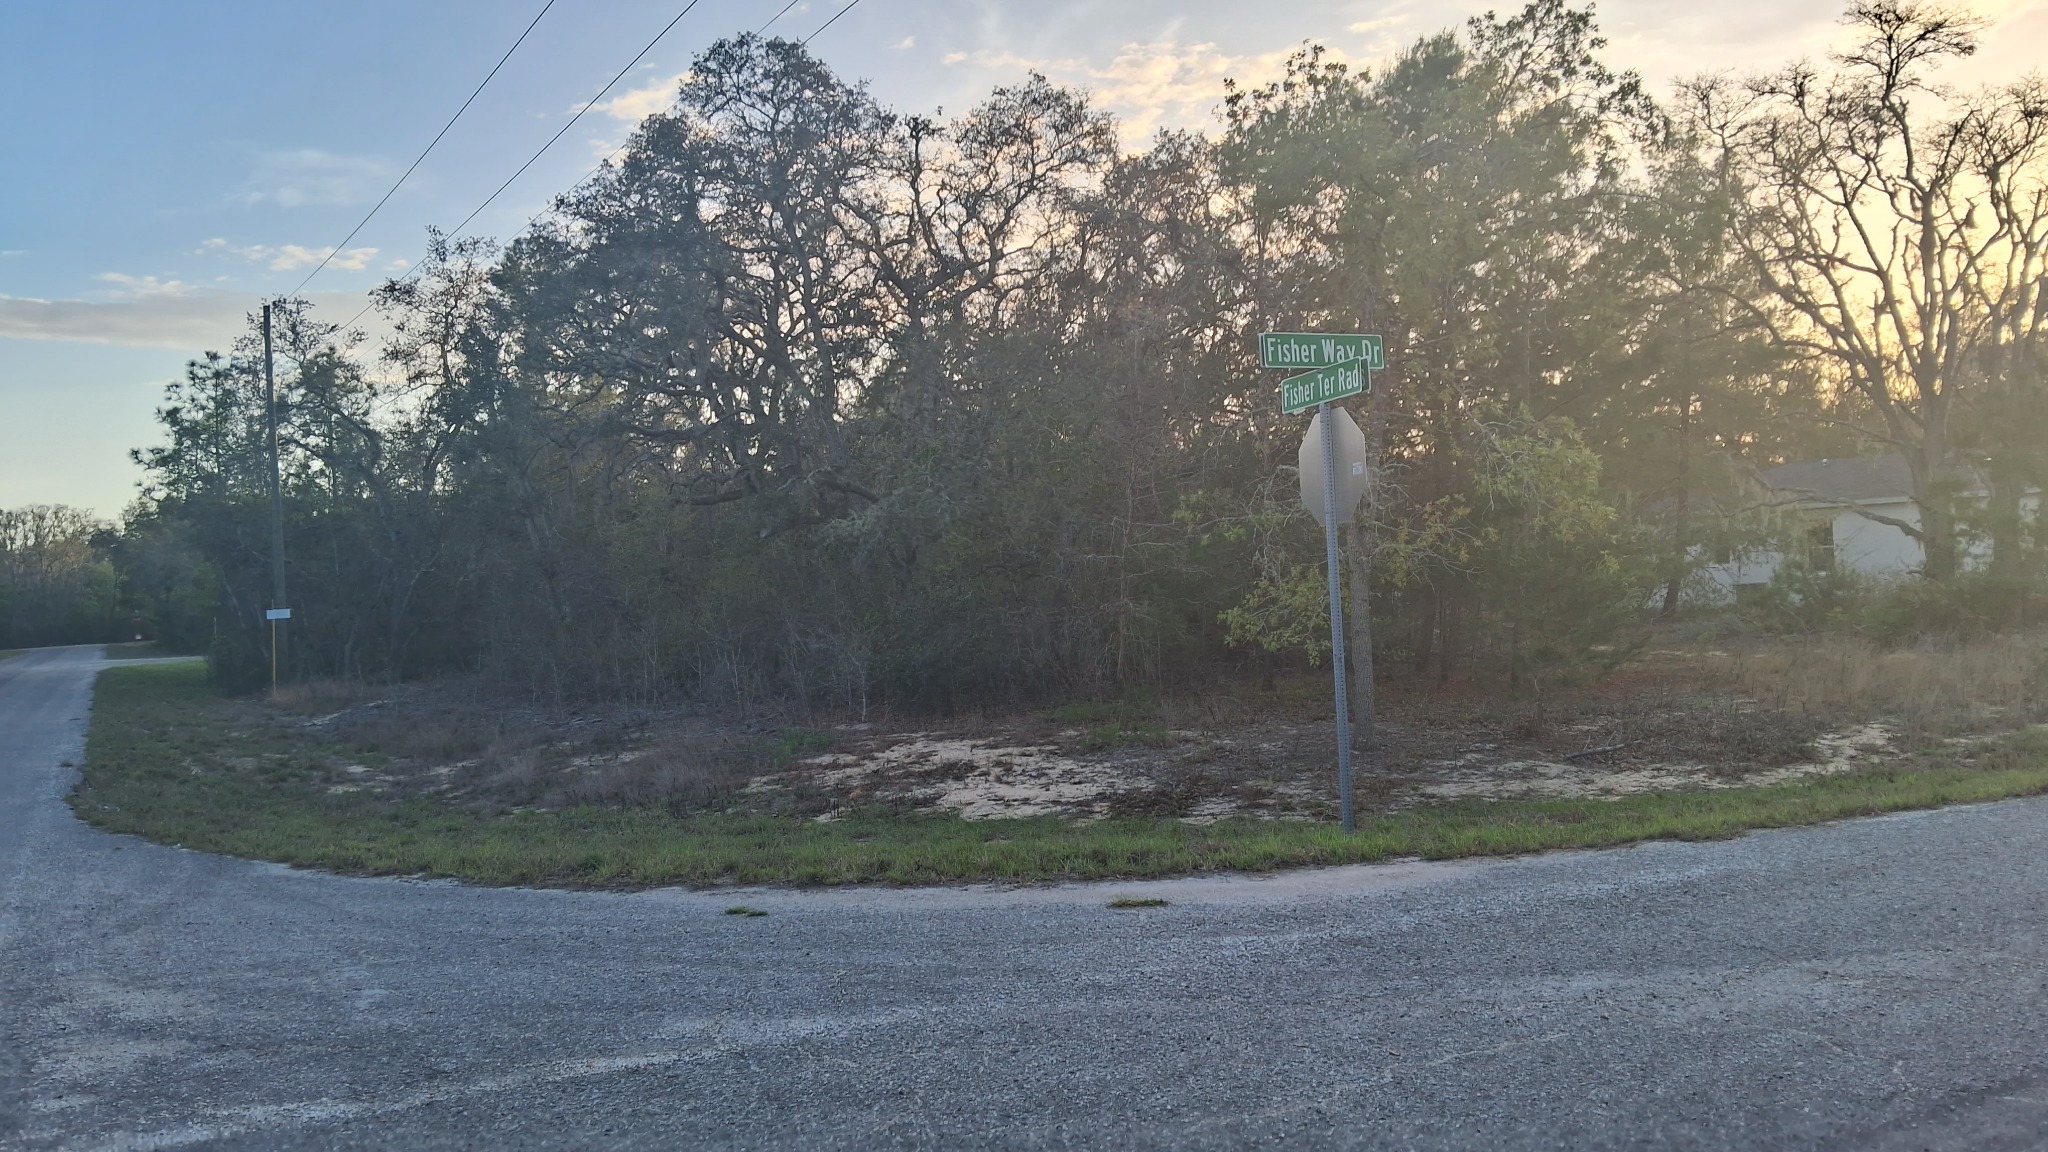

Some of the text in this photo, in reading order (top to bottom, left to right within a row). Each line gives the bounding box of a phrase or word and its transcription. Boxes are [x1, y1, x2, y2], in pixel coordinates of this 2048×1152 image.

[1266, 337, 1380, 364] Fisher Way Dr
[1283, 362, 1359, 408] Fisher Ter Rad
